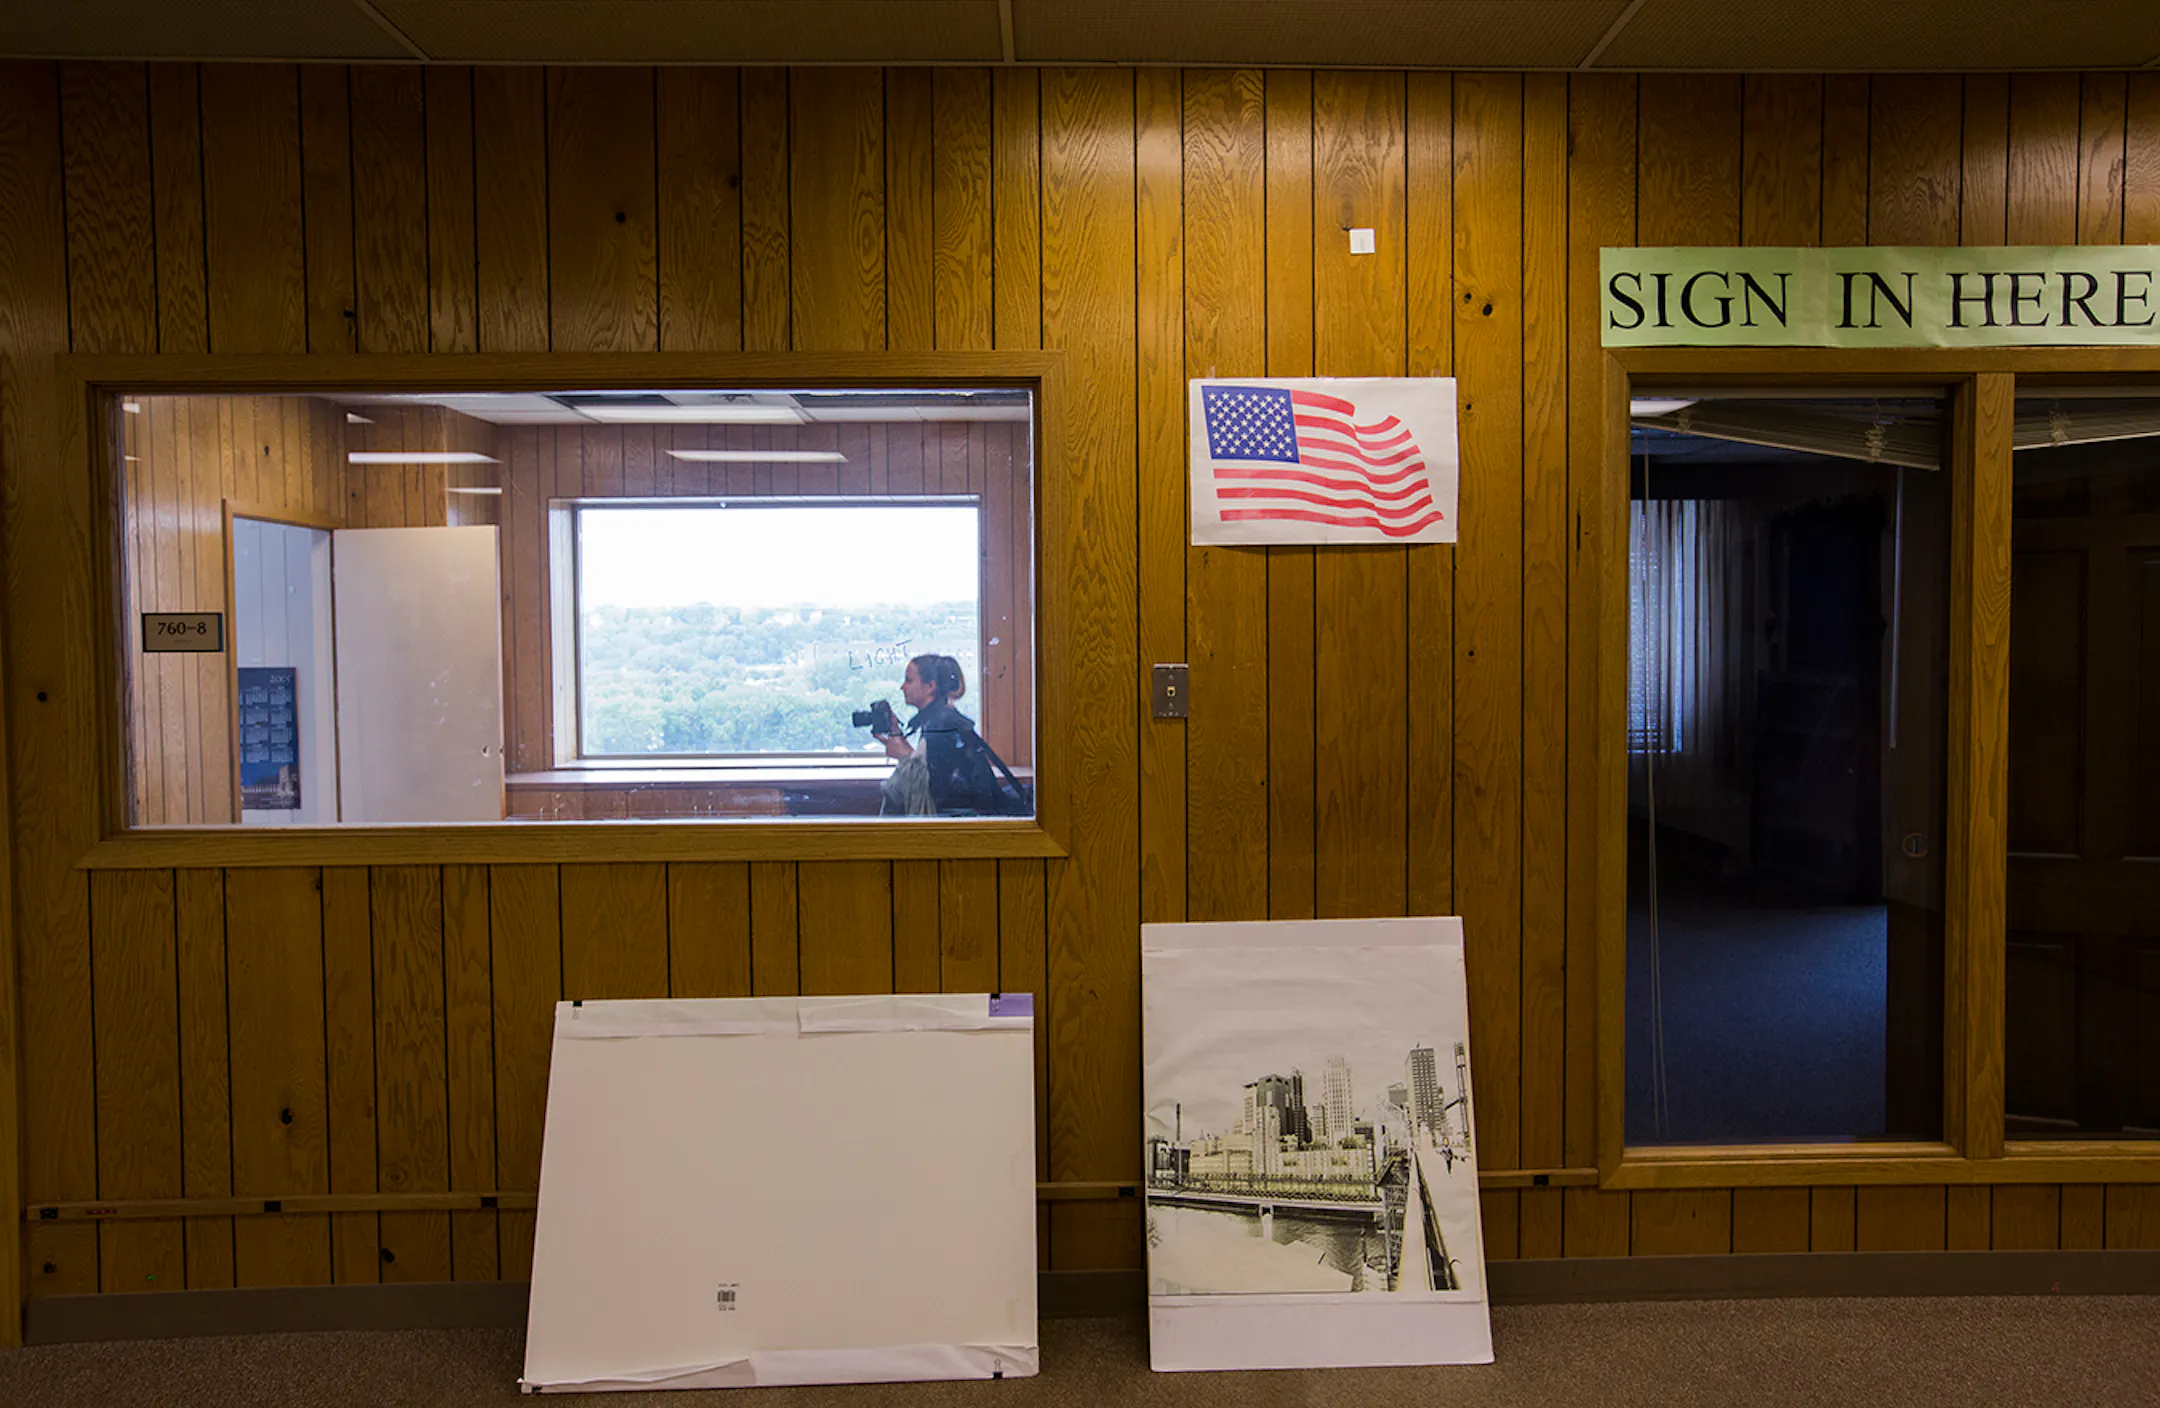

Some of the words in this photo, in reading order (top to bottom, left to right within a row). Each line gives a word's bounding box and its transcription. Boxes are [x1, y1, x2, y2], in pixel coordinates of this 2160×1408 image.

[1608, 271, 1792, 329] SIGN
[1835, 271, 1919, 329] IN
[1945, 271, 2157, 328] HERE
[157, 622, 207, 635] 760-8
